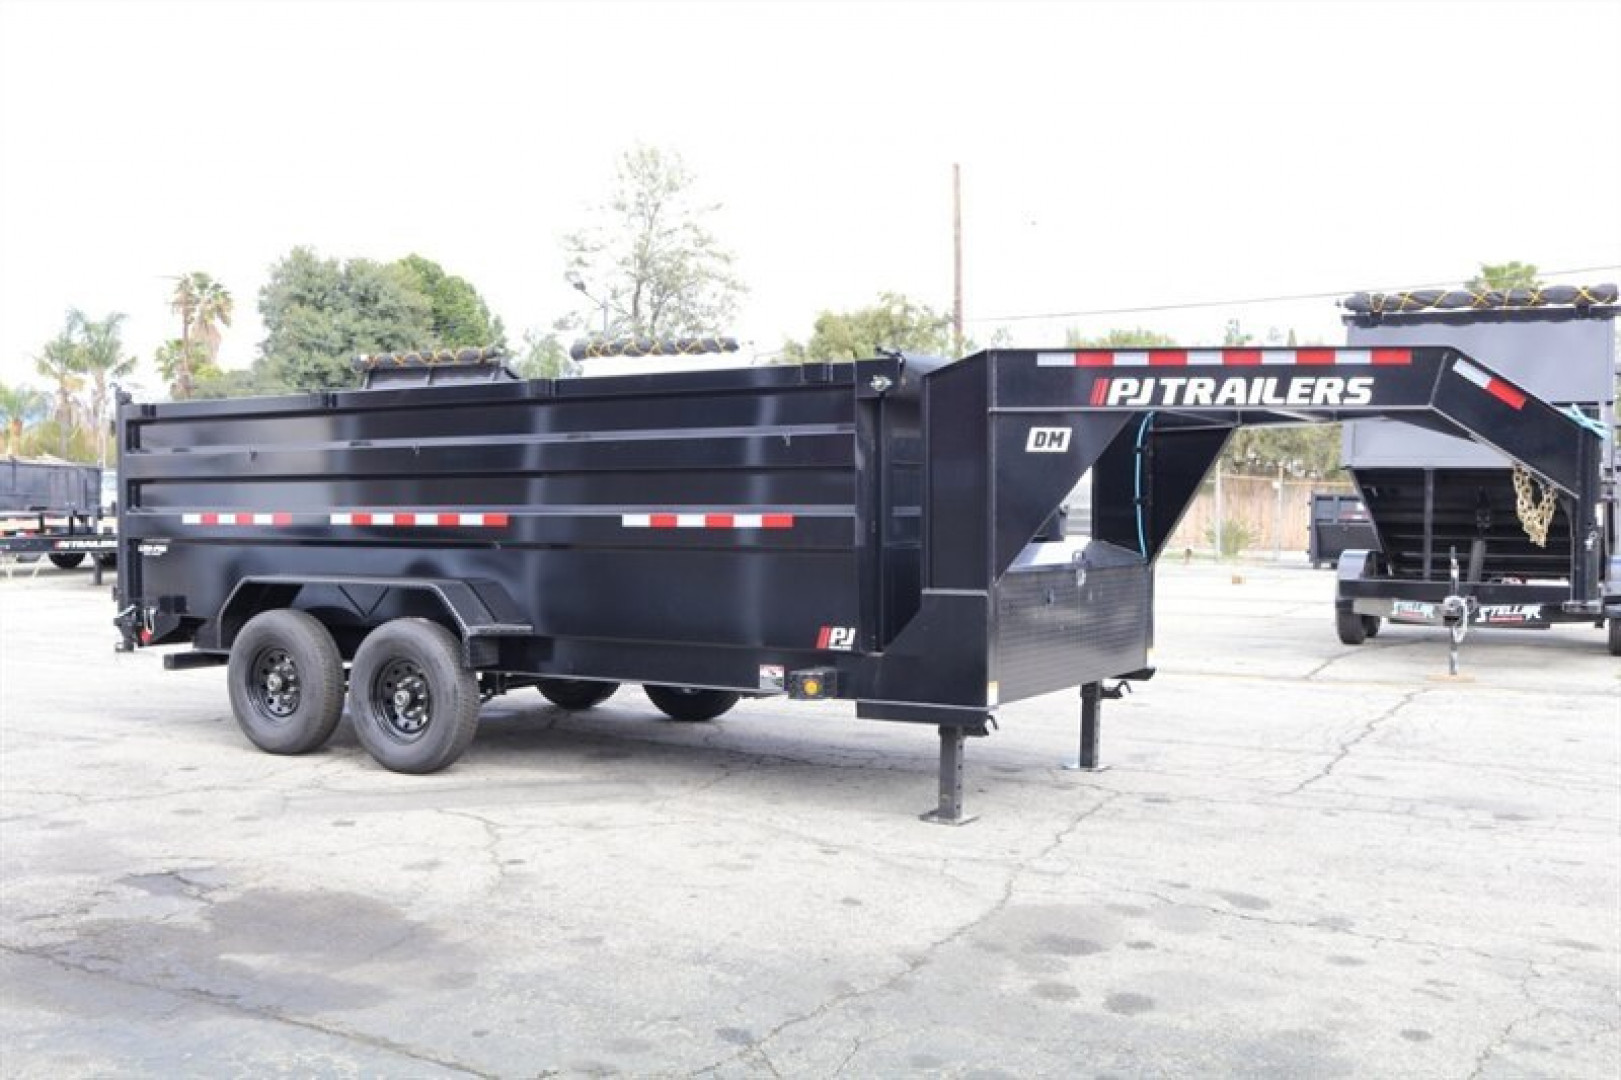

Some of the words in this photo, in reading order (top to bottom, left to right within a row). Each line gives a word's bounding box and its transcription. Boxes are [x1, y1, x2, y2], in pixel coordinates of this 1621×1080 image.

[1106, 377, 1155, 406] PJ
[1158, 377, 1374, 406] TRAILERS
[1033, 431, 1065, 448] DM
[828, 627, 856, 646] PJ
